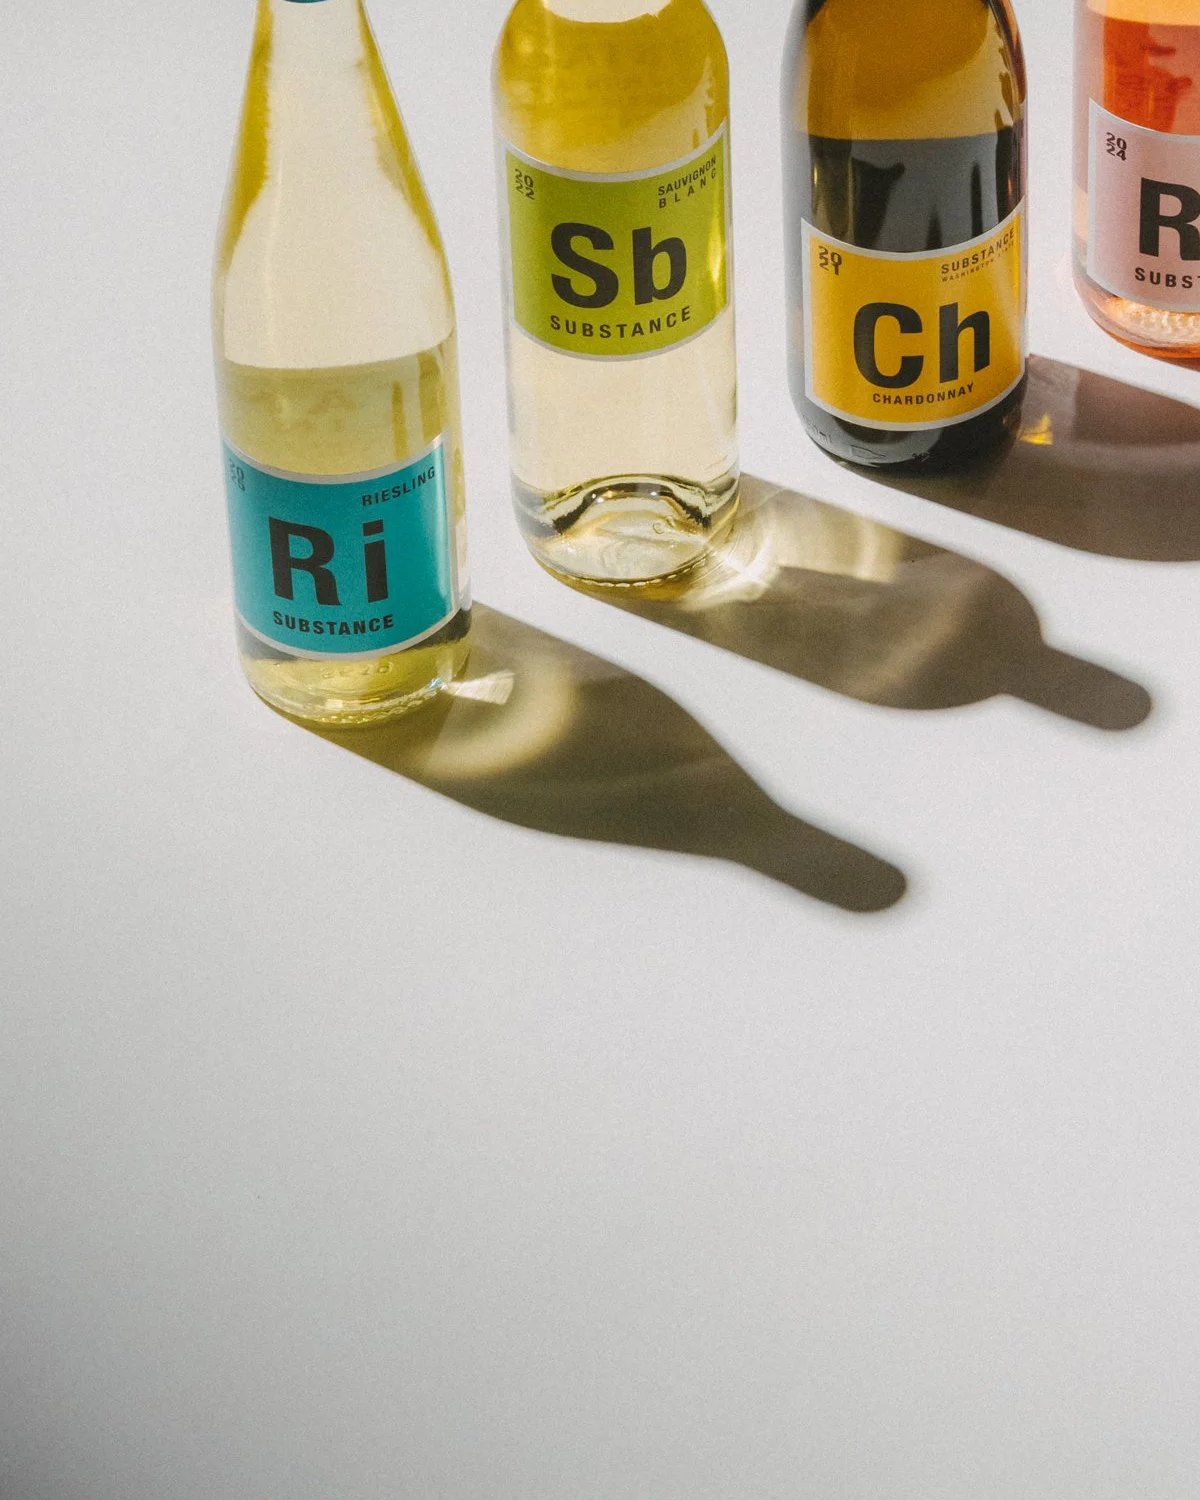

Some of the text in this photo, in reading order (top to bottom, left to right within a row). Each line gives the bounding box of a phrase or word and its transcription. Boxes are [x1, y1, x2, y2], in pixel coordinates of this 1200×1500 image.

[1106, 132, 1128, 151] 20
[1106, 142, 1127, 161] 24
[514, 168, 534, 188] 20
[515, 179, 535, 200] 22
[657, 155, 717, 196] SAUVIGNON
[658, 169, 718, 209] BLANC
[550, 222, 687, 309] Sb
[941, 227, 1015, 274] SUBSTANCE
[550, 306, 691, 339] SUBSTANCE
[853, 302, 991, 389] Ch
[872, 382, 974, 405] CHARDONNAY
[362, 466, 436, 507] RIESLING
[268, 516, 389, 606] Ri
[273, 611, 394, 636] SUBSTANCE
